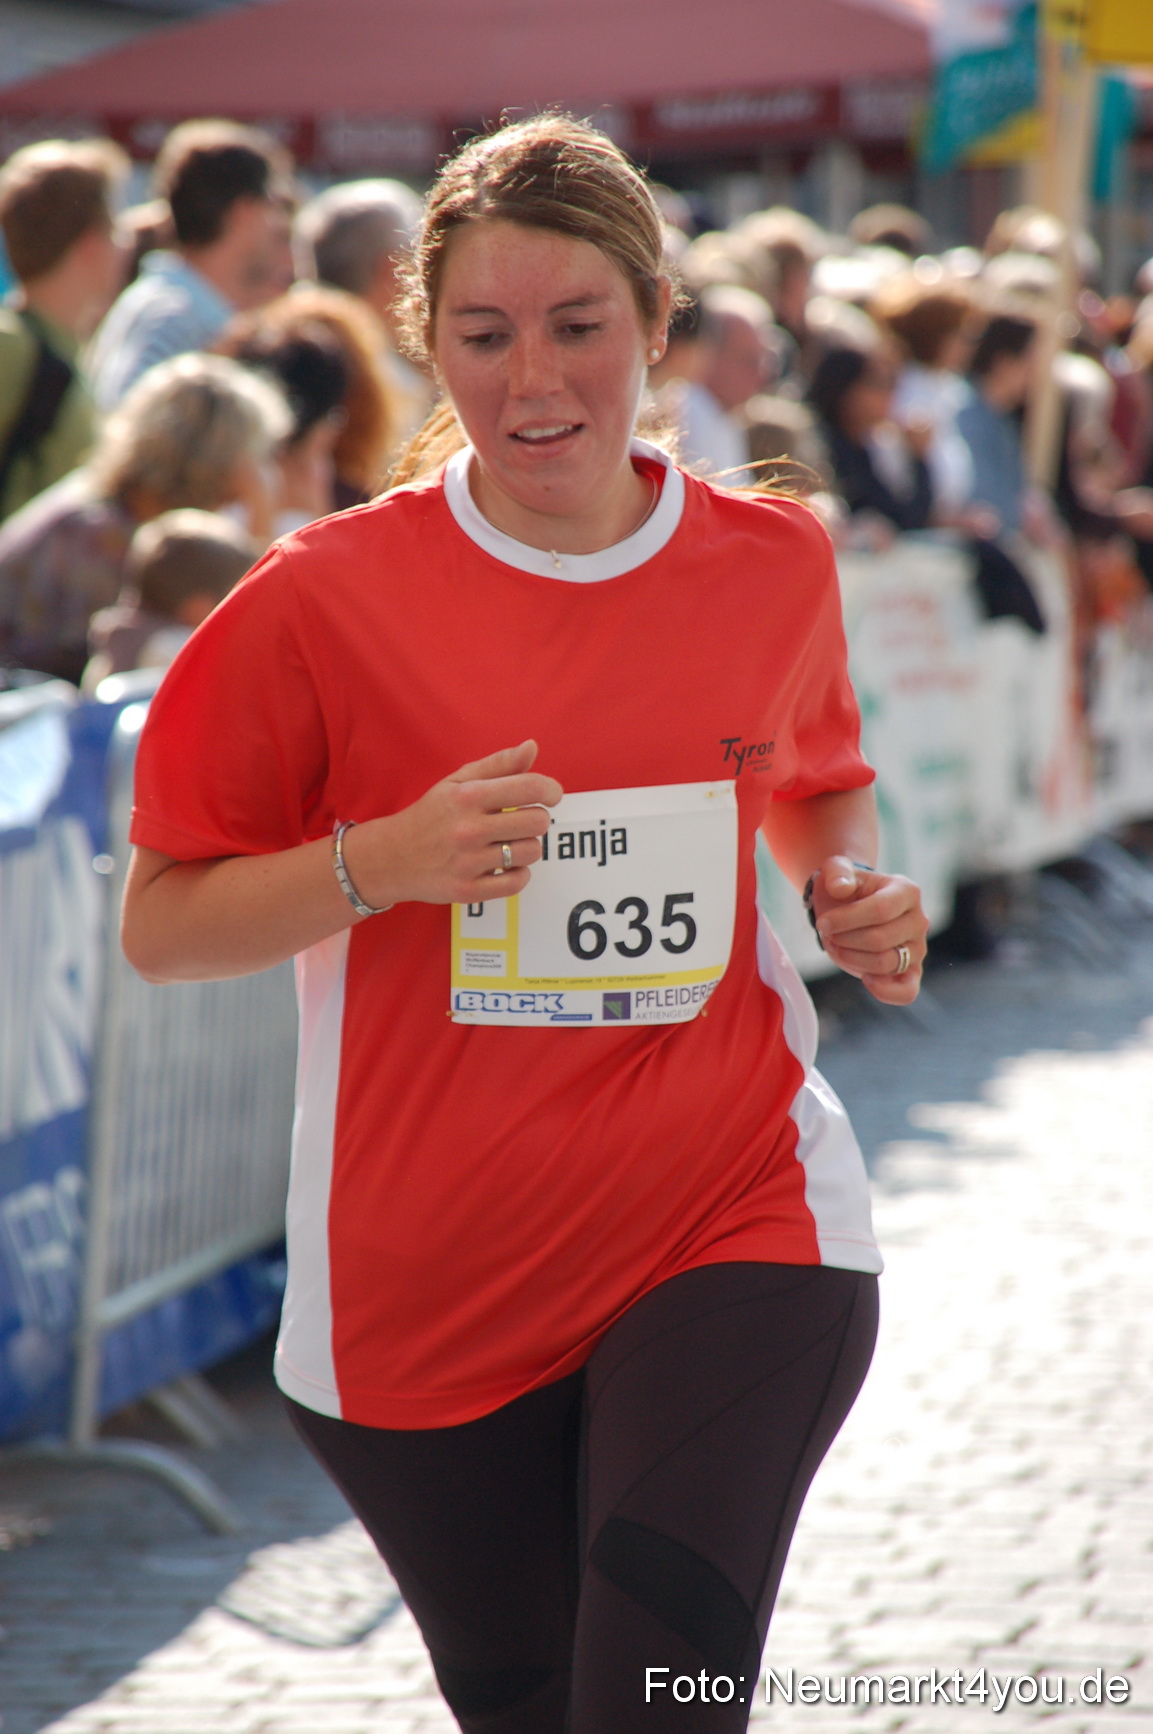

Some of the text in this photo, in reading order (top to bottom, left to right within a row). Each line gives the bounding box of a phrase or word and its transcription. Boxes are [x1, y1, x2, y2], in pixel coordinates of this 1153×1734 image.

[720, 737, 775, 776] Tyron
[567, 892, 697, 961] 635
[455, 991, 564, 1014] BOCK
[635, 980, 719, 1008] PFLEIDERE
